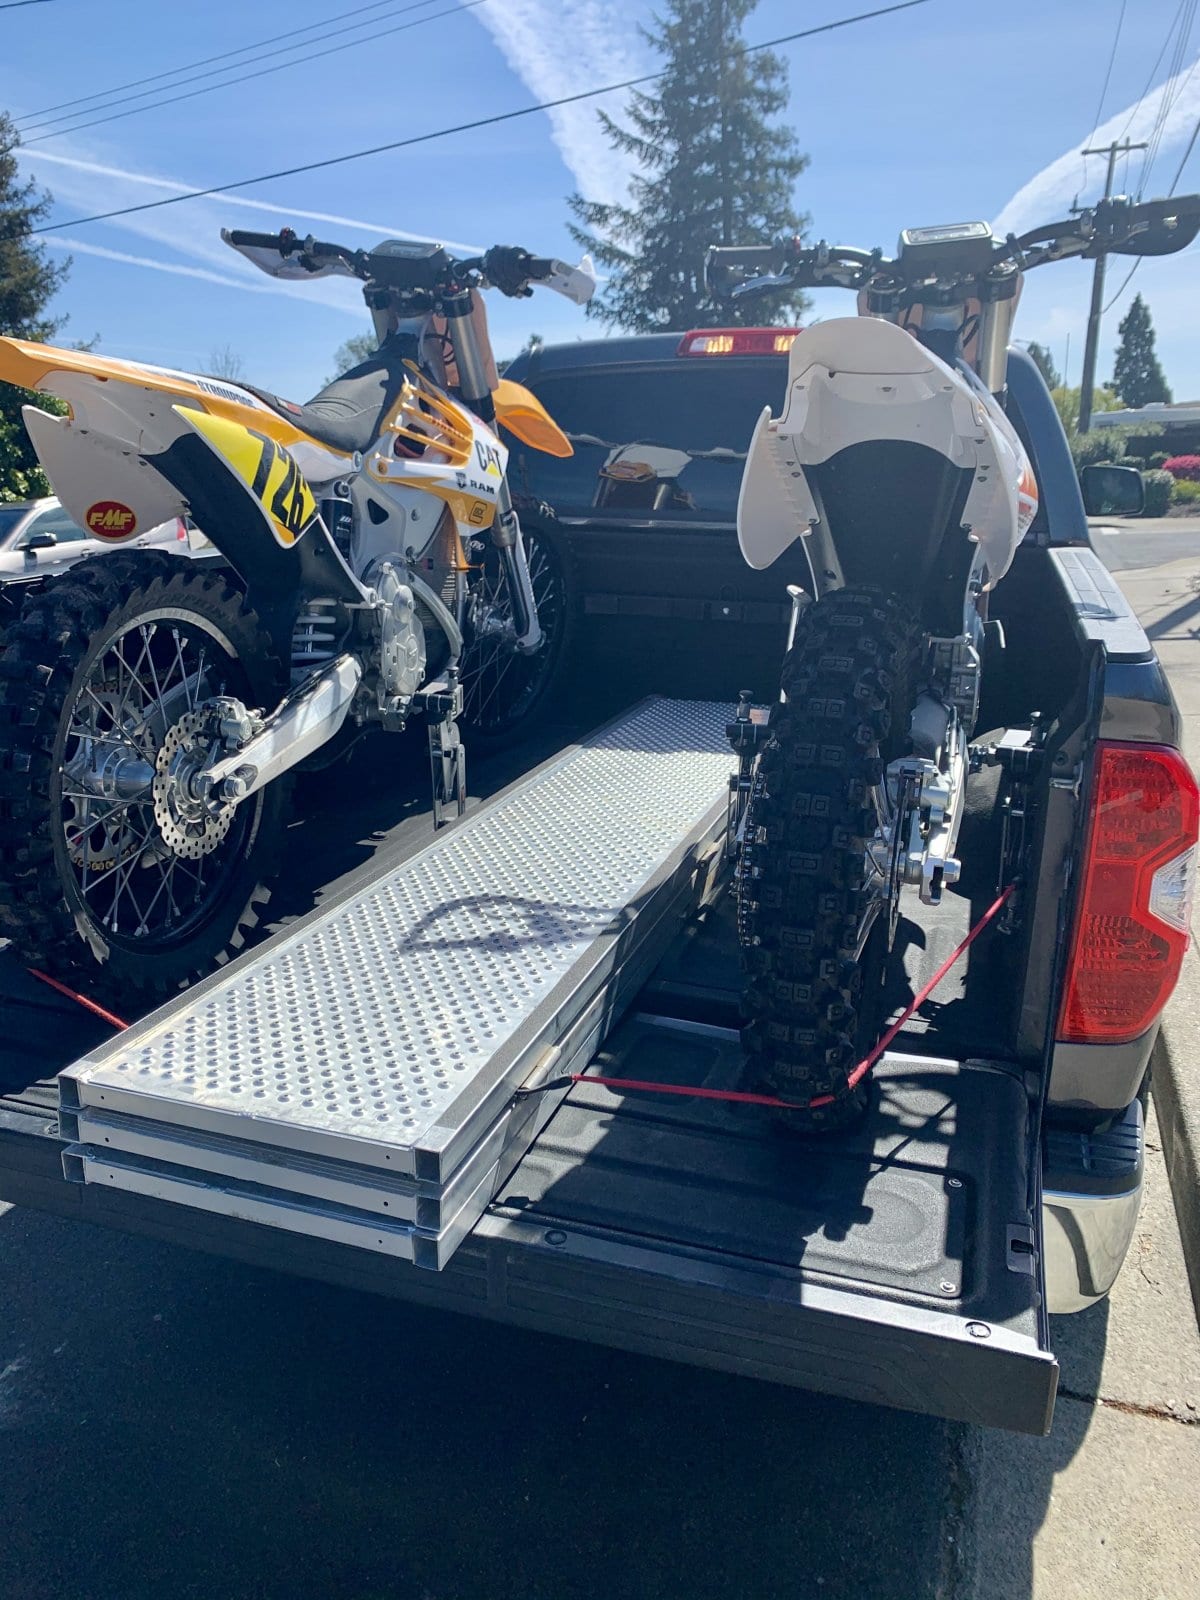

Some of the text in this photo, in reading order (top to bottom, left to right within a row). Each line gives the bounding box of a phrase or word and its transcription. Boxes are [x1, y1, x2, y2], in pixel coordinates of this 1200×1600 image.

[475, 440, 504, 478] CAT
[470, 480, 495, 495] RAM
[90, 509, 132, 526] FMF
